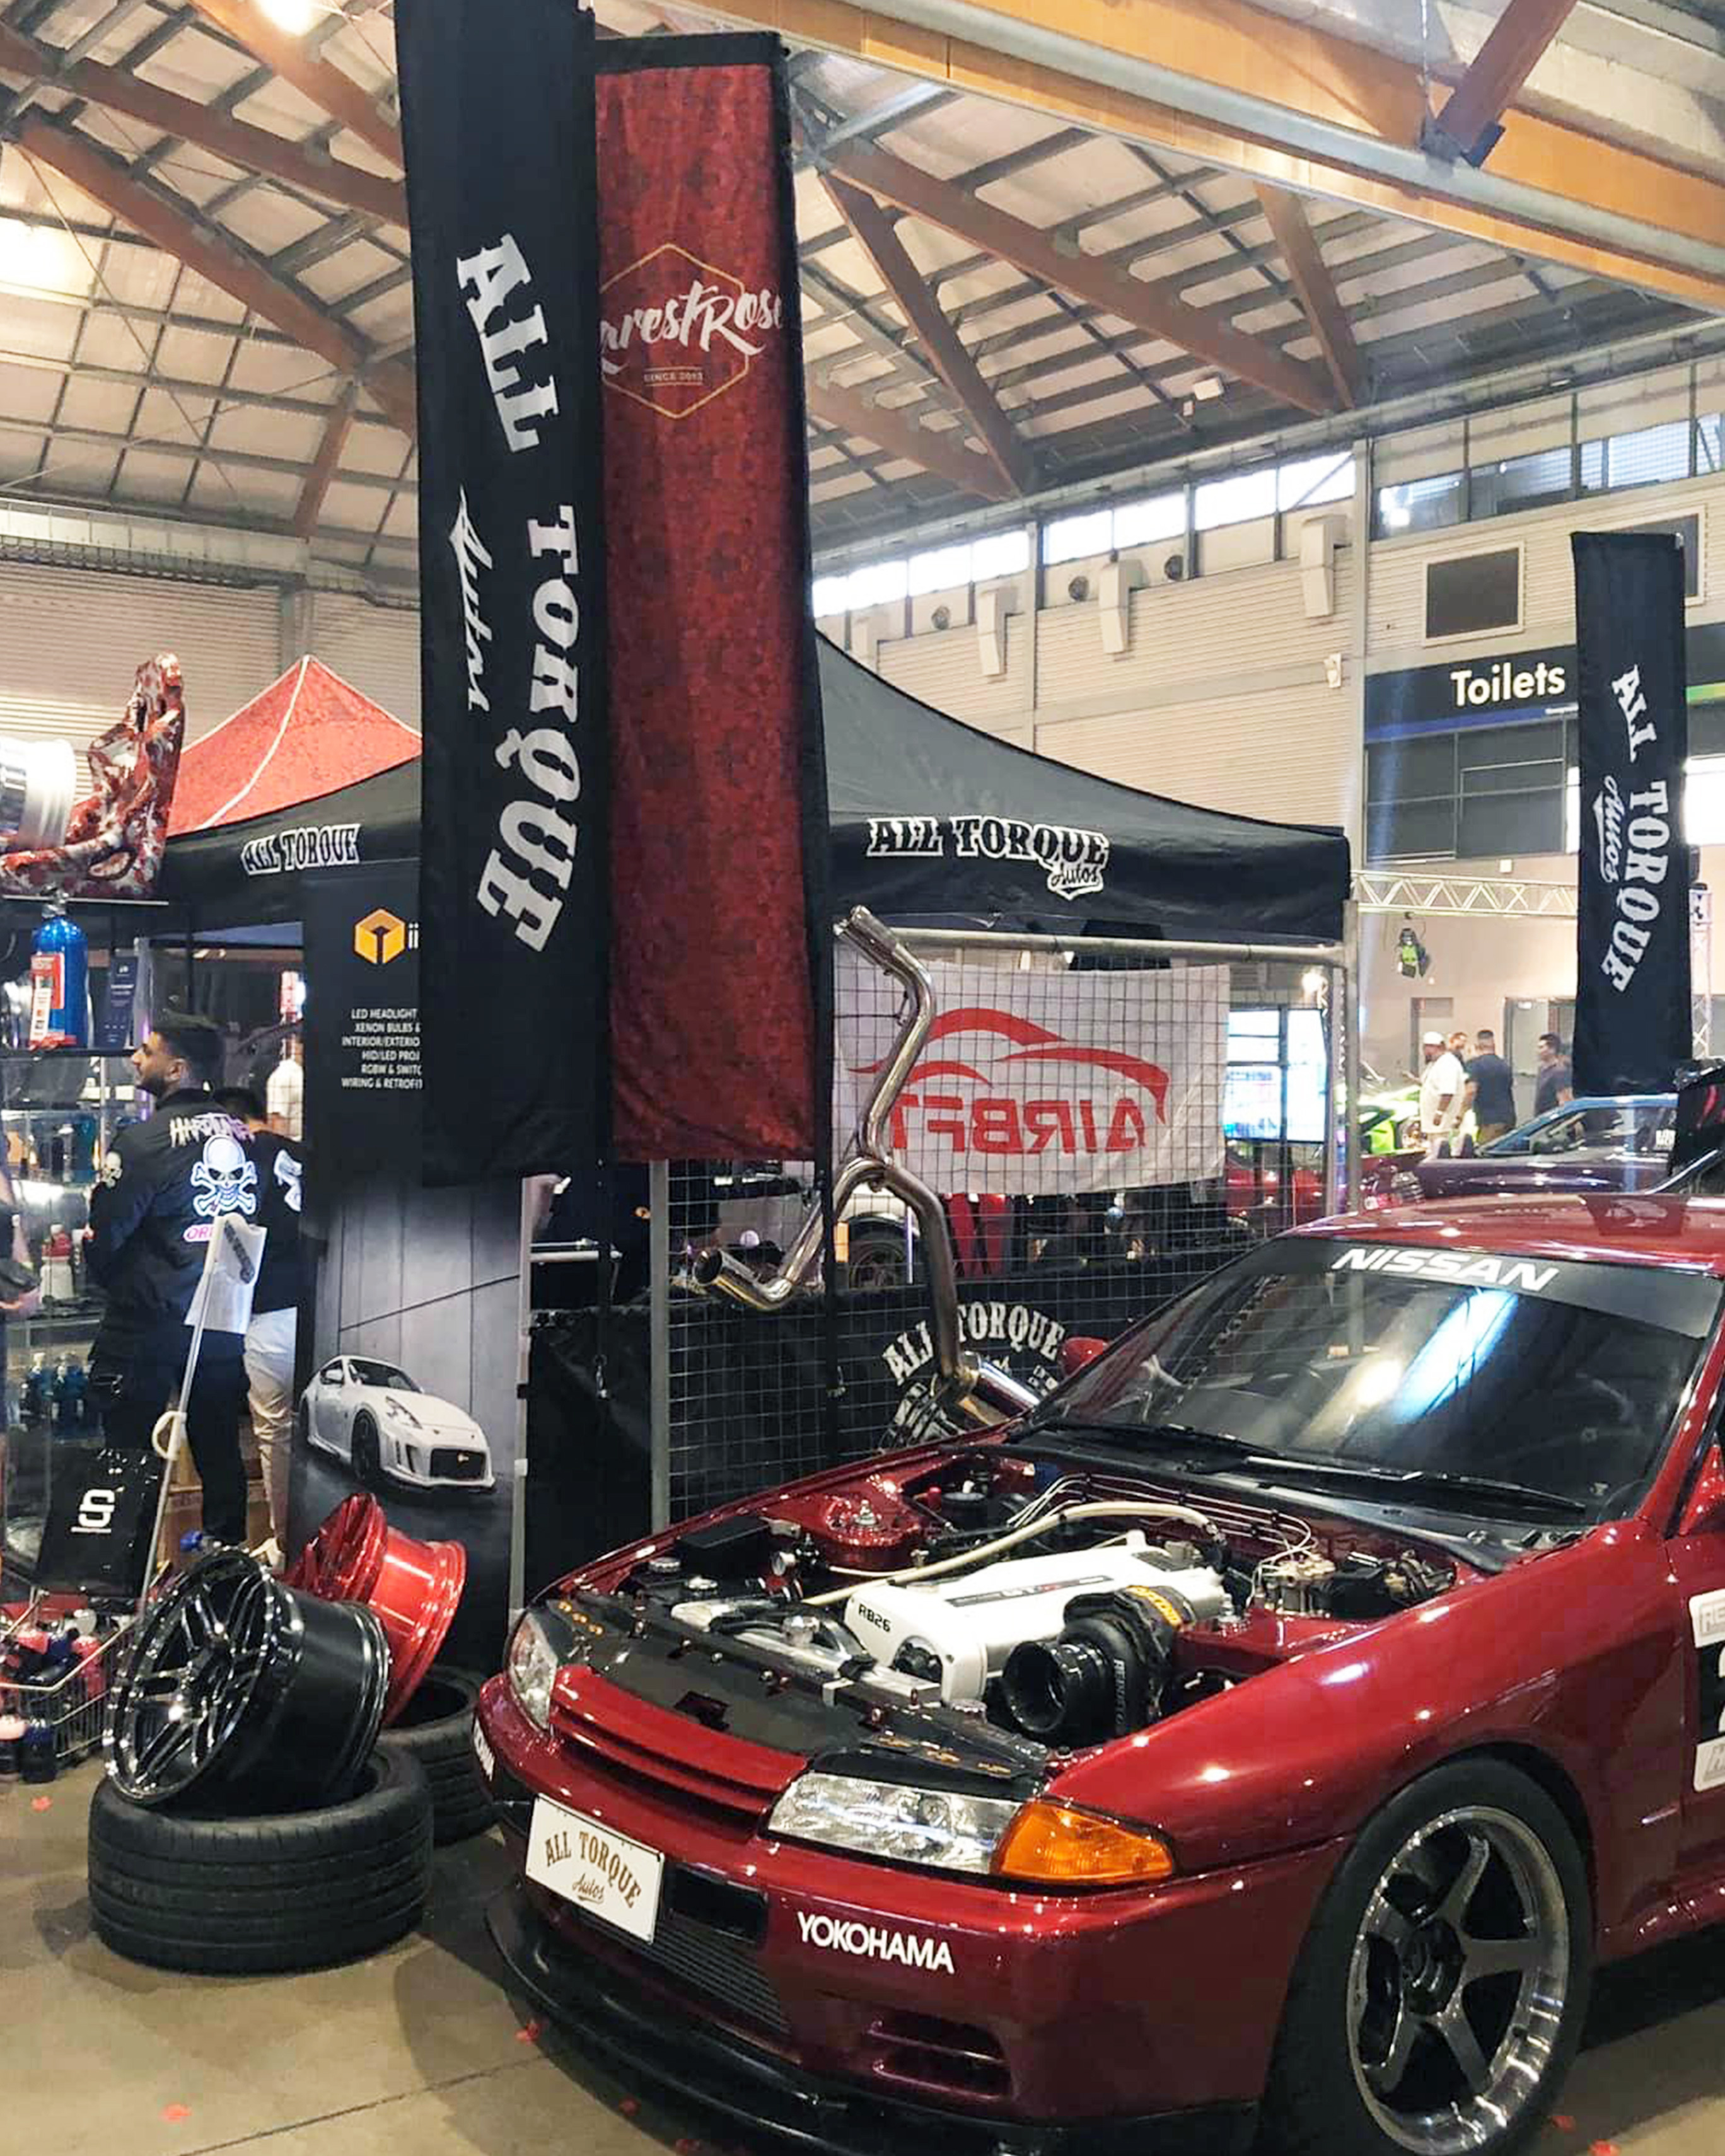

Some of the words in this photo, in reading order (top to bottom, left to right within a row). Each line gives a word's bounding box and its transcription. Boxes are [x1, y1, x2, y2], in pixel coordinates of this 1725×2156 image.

[456, 233, 559, 452] ALL
[644, 373, 676, 383] SINCE
[1451, 662, 1565, 706] Toilets
[477, 504, 581, 952] TORQUE
[1612, 664, 1658, 763] ALL
[280, 823, 361, 872] TORQUE
[867, 817, 944, 856] ALL
[949, 816, 1110, 871] TORQUE
[1595, 775, 1625, 883] Autos
[1050, 861, 1103, 890] Autos
[1600, 780, 1670, 992] TORQUE
[351, 1008, 368, 1019] LED
[369, 1008, 417, 1019] HEADLIGHT
[354, 1022, 385, 1033] XENON
[341, 1077, 375, 1088] WIRING
[375, 1078, 383, 1088] &
[1331, 1248, 1560, 1292] NISSAN
[881, 1319, 934, 1386] ALL
[858, 1603, 892, 1633] RB26
[545, 1831, 572, 1867] ALL
[579, 1831, 642, 1909] TORQUE
[572, 1873, 605, 1903] Autos
[797, 1911, 955, 1974] YOKOHAMA
